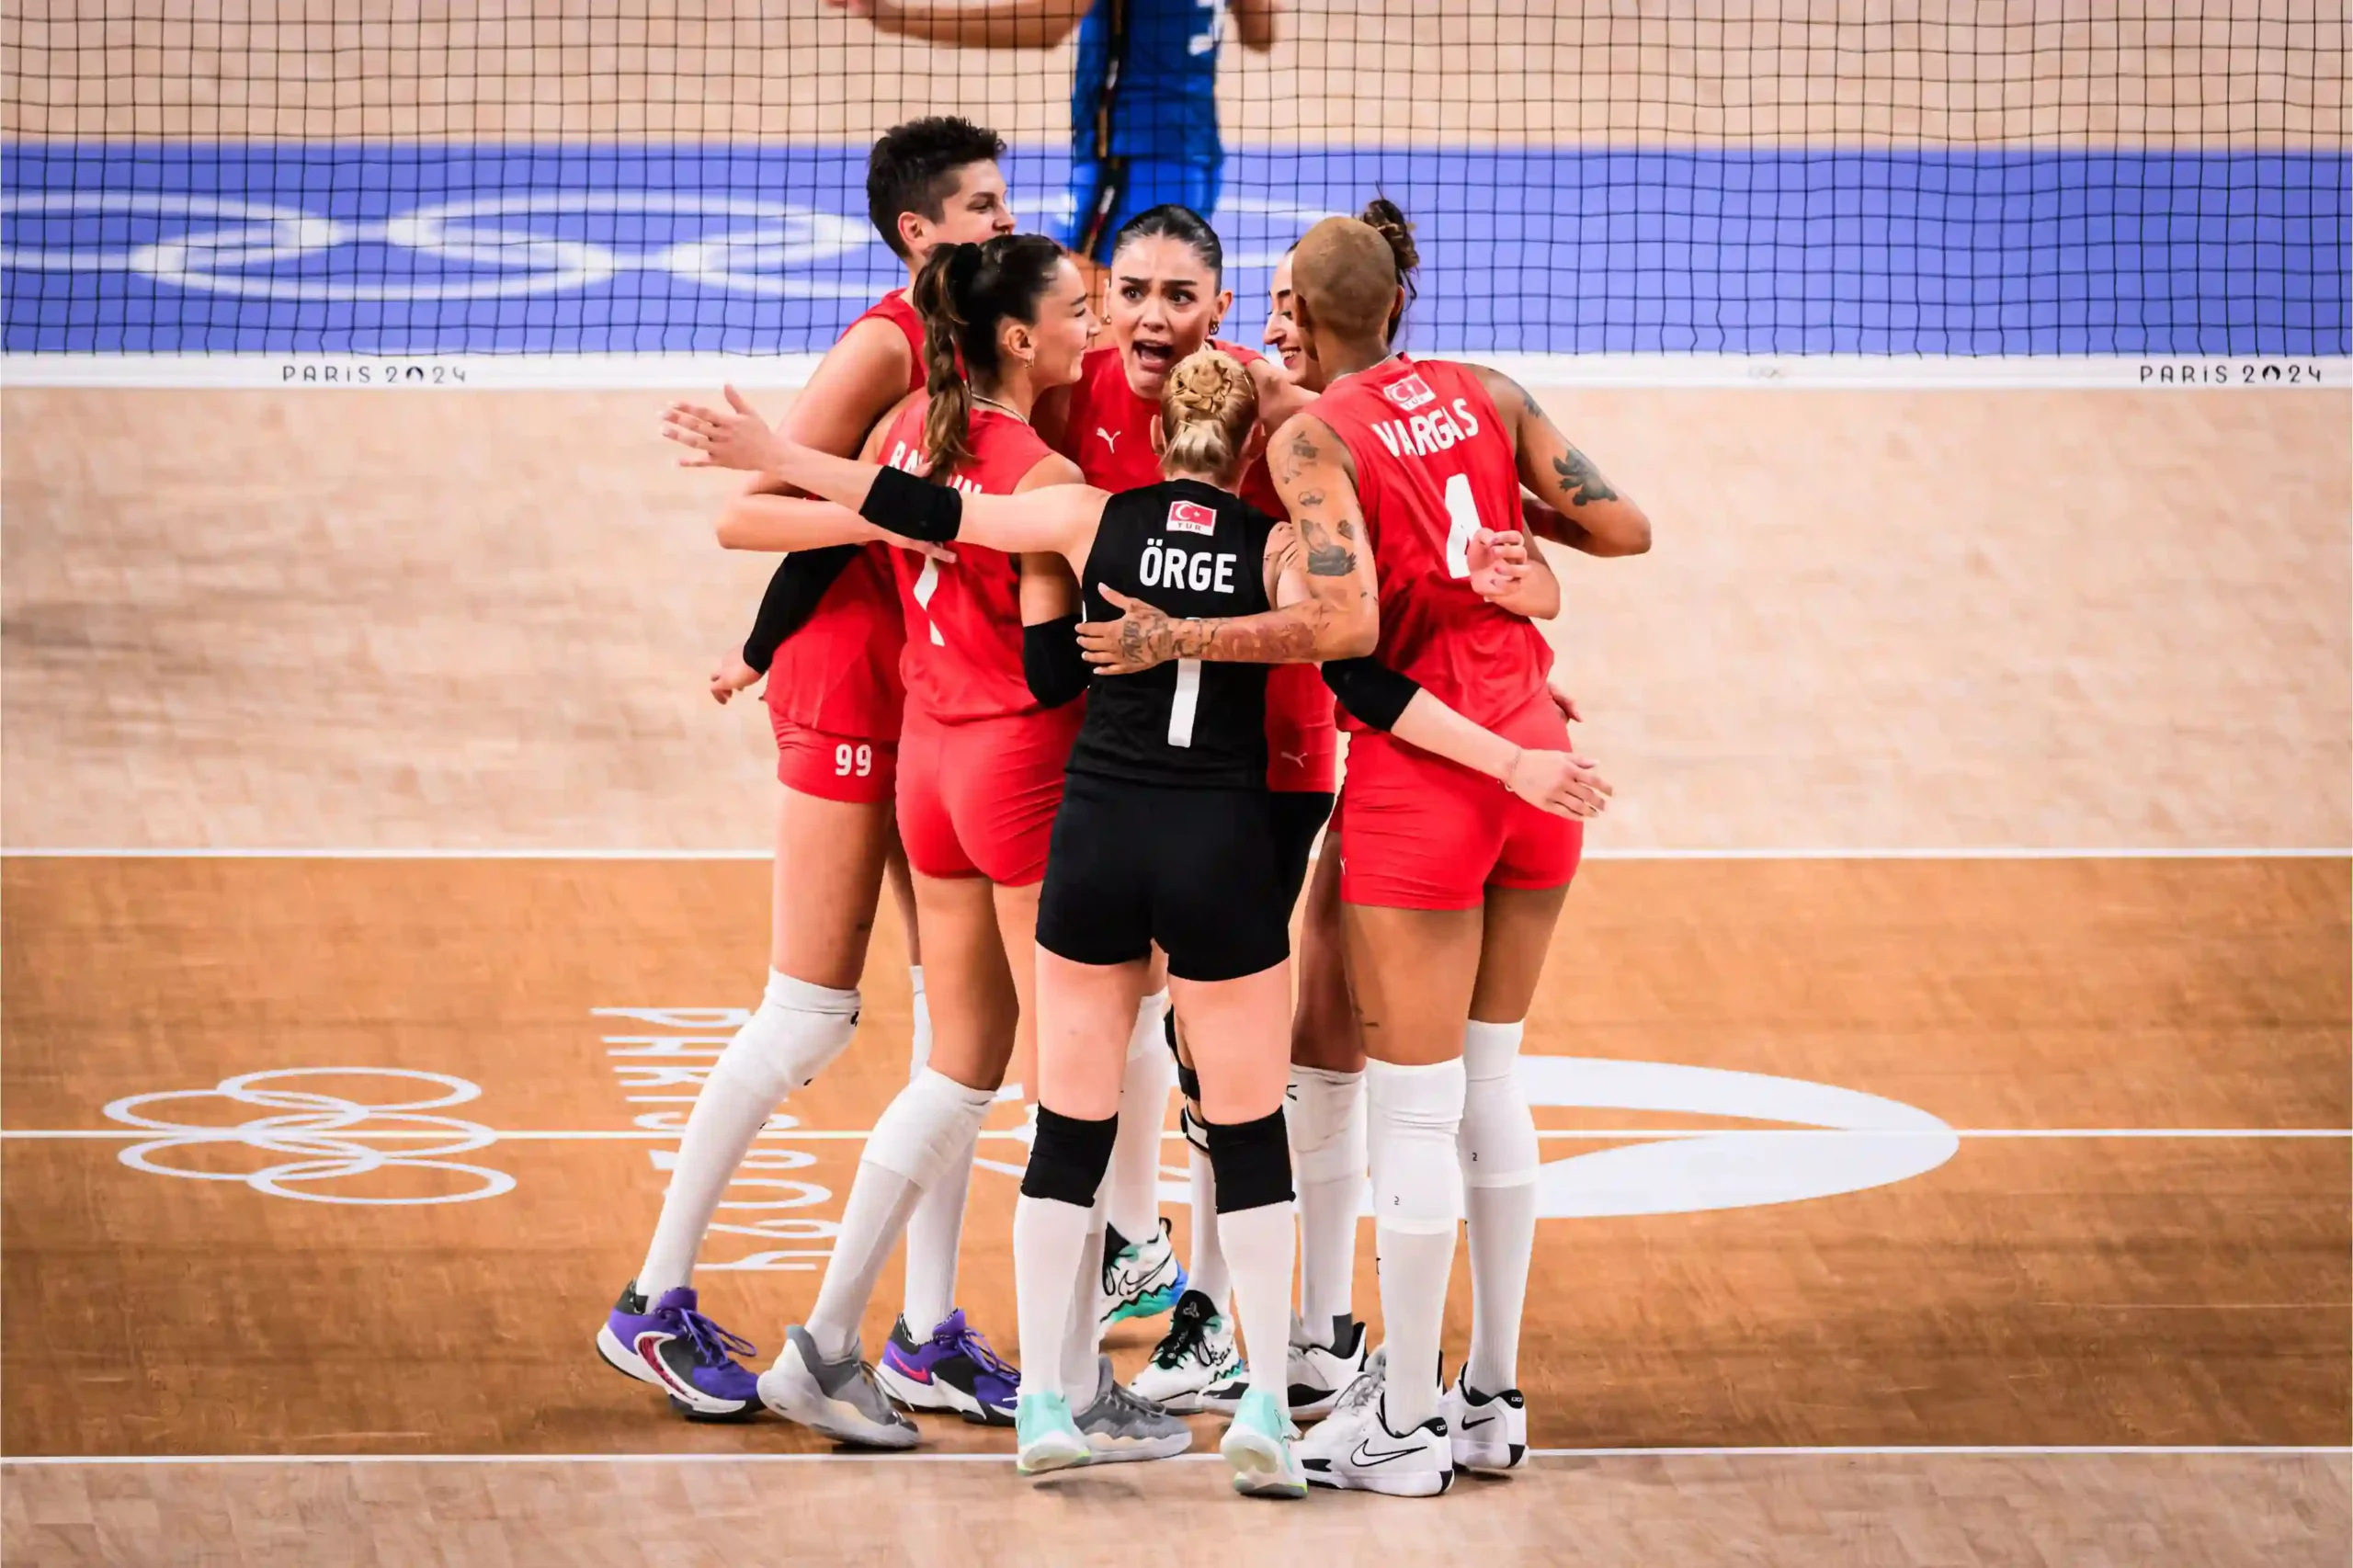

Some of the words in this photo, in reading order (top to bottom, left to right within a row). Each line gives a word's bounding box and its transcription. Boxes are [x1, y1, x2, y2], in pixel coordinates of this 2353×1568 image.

[385, 366, 466, 383] 2024
[2243, 365, 2321, 383] 2024
[1371, 398, 1479, 458] VARGAS
[1177, 522, 1202, 531] TUR
[1139, 538, 1237, 594] ÖRGE
[1167, 617, 1202, 748] 1
[835, 744, 872, 777] 99
[1472, 1152, 1478, 1162] 2
